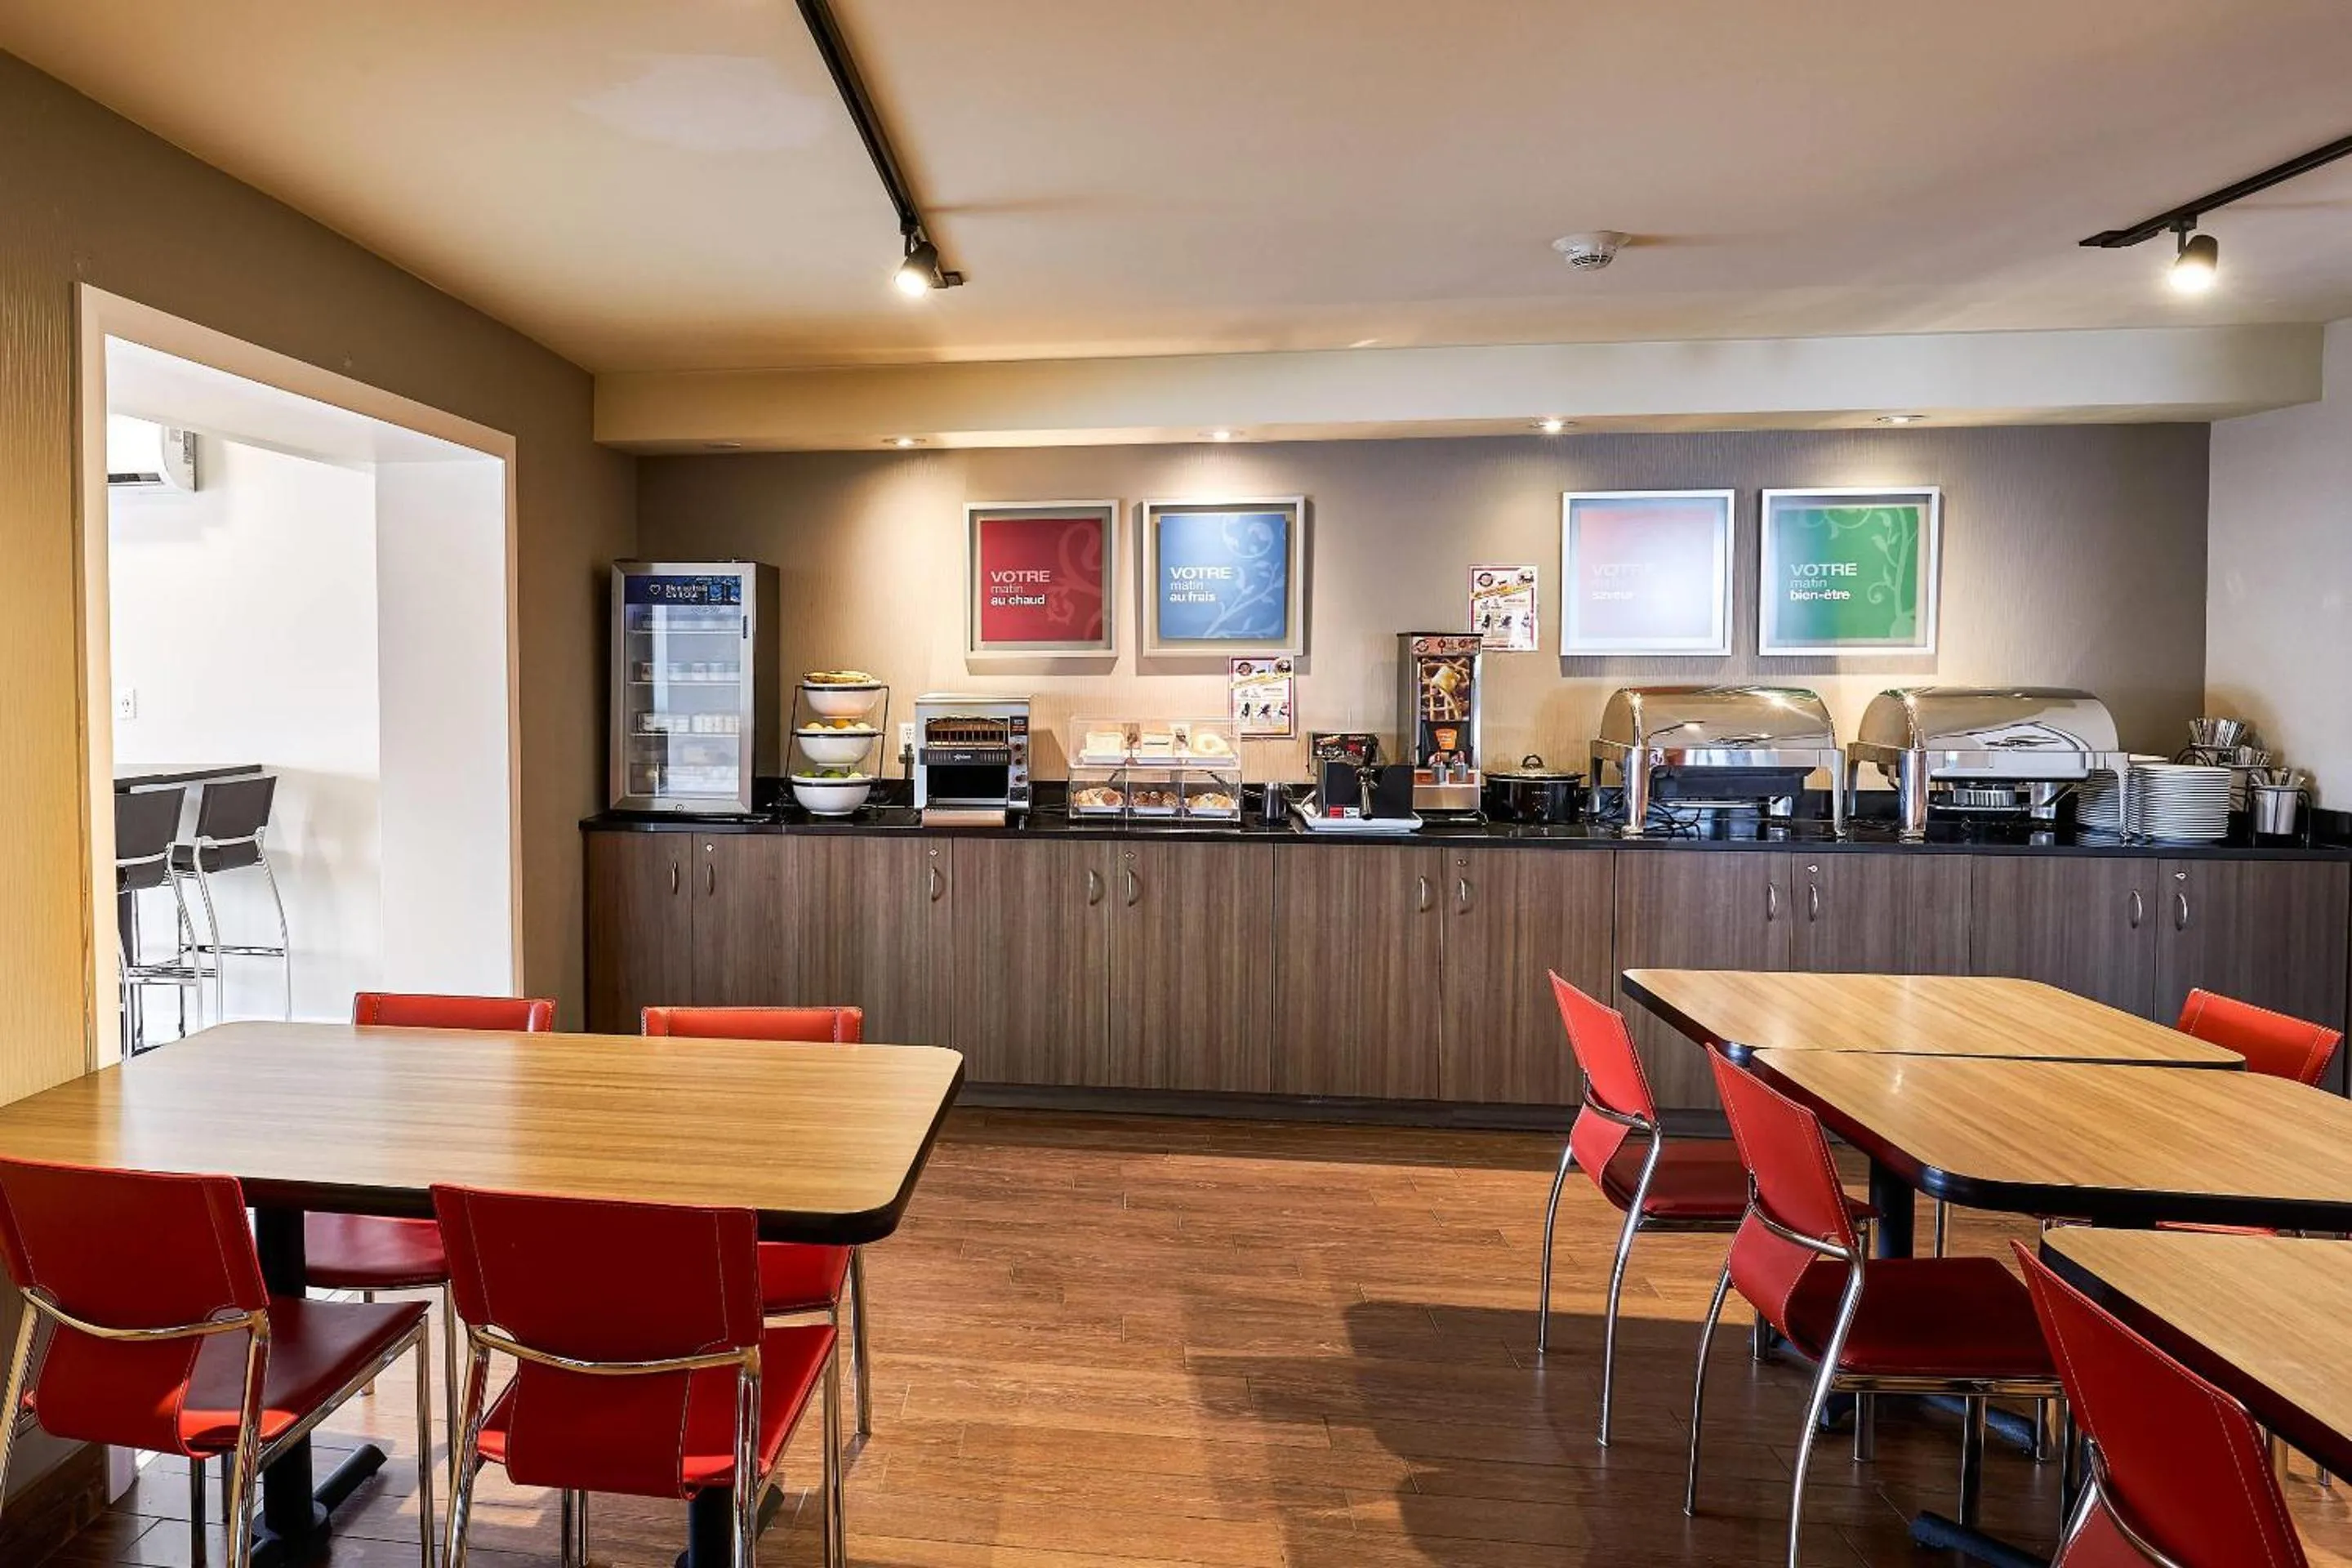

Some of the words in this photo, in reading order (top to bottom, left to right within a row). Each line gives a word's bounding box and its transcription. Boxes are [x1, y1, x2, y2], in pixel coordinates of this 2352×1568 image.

[1169, 567, 1232, 580] VOTRE
[1790, 563, 1858, 577] VOTRE
[990, 570, 1051, 583] VOTRE
[1790, 577, 1828, 588] matin
[990, 583, 1023, 594] matin
[1169, 580, 1204, 590] matin
[990, 596, 1006, 606] au
[1009, 594, 1045, 605] chaud
[1169, 594, 1186, 603] au
[1188, 591, 1216, 603] frais
